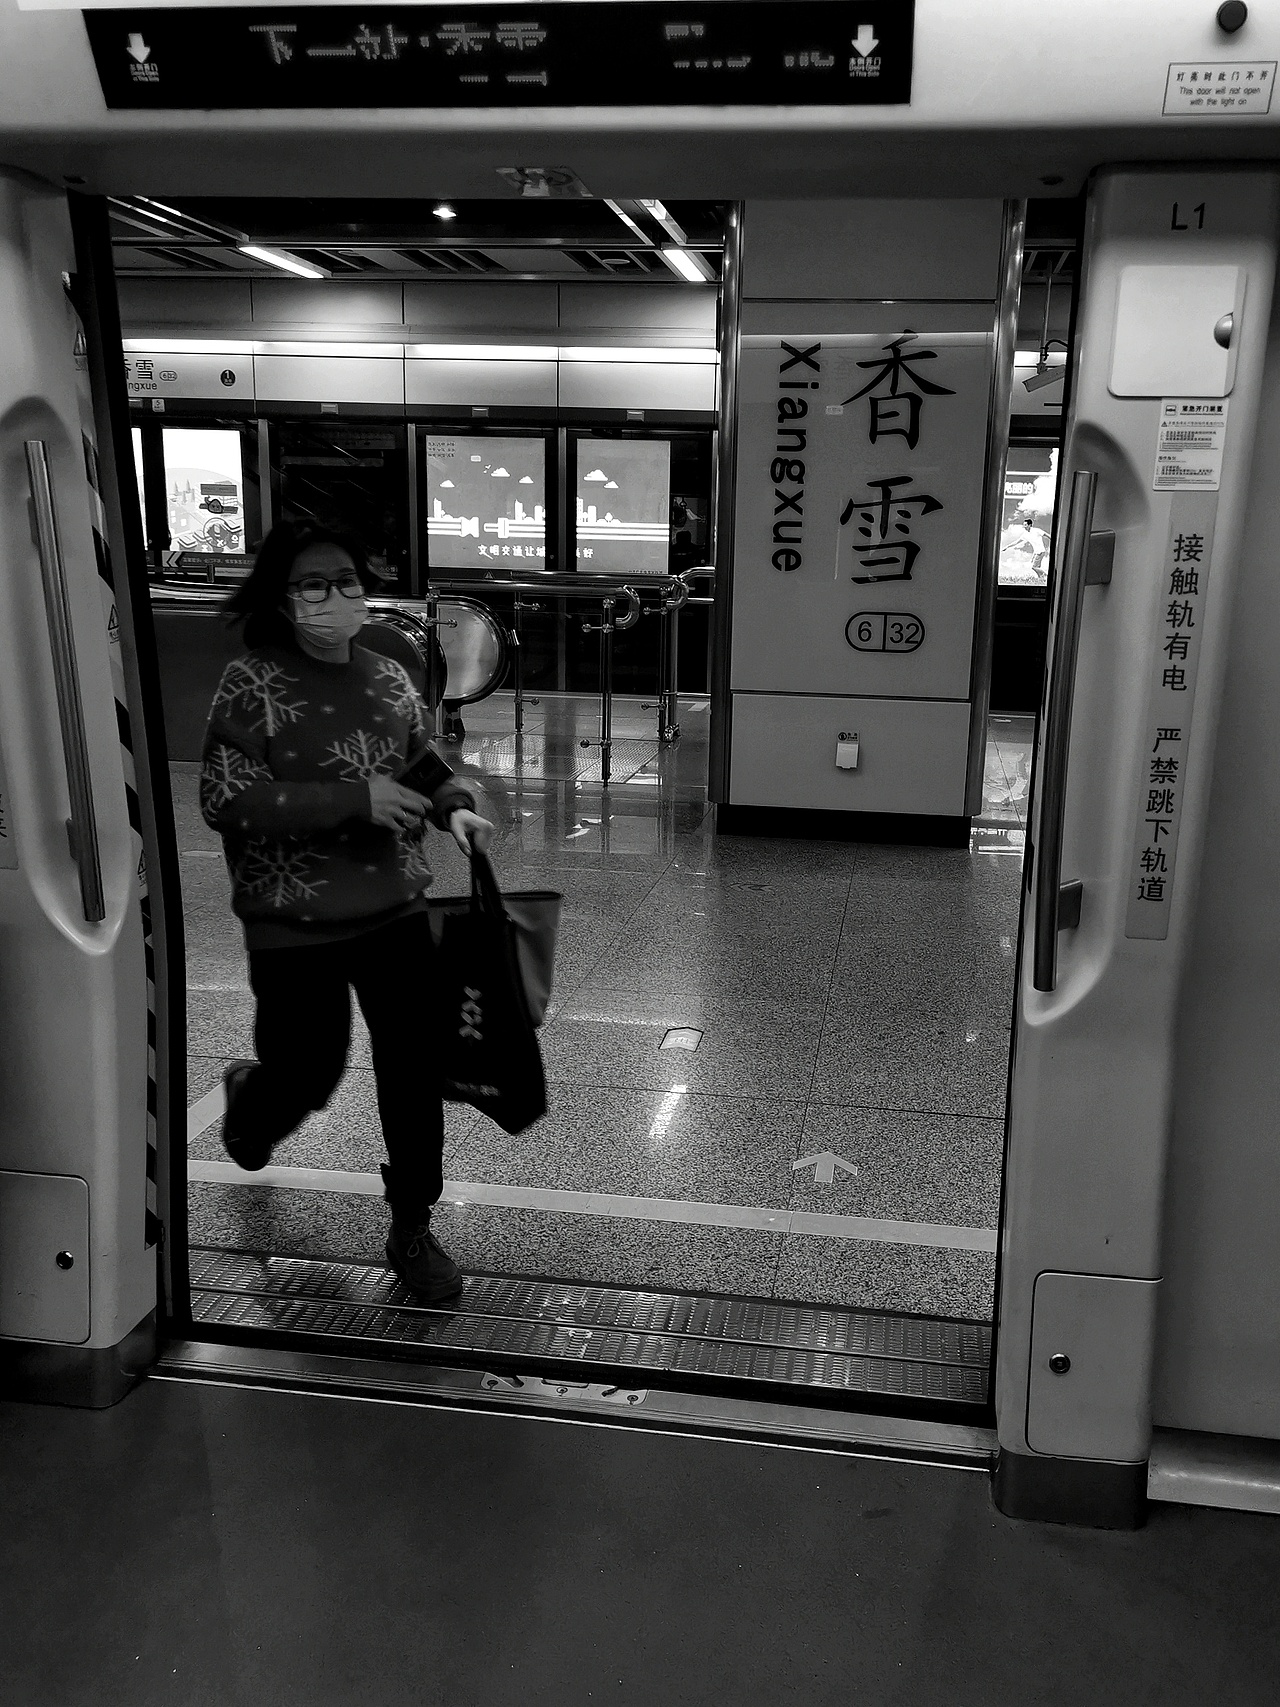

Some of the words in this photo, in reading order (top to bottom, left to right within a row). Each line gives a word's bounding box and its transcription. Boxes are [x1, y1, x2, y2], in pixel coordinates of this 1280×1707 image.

[1180, 86, 1193, 95] This
[1196, 86, 1212, 95] door
[1215, 86, 1226, 95] will
[1229, 86, 1241, 95] not
[1243, 87, 1260, 95] open
[1171, 202, 1206, 230] L1
[770, 339, 822, 573] Xiangxue
[840, 329, 957, 584] 香雪
[889, 622, 920, 645] 32
[1162, 533, 1204, 691] 接触轨有电
[1137, 727, 1182, 902] 严禁跳下轨道
